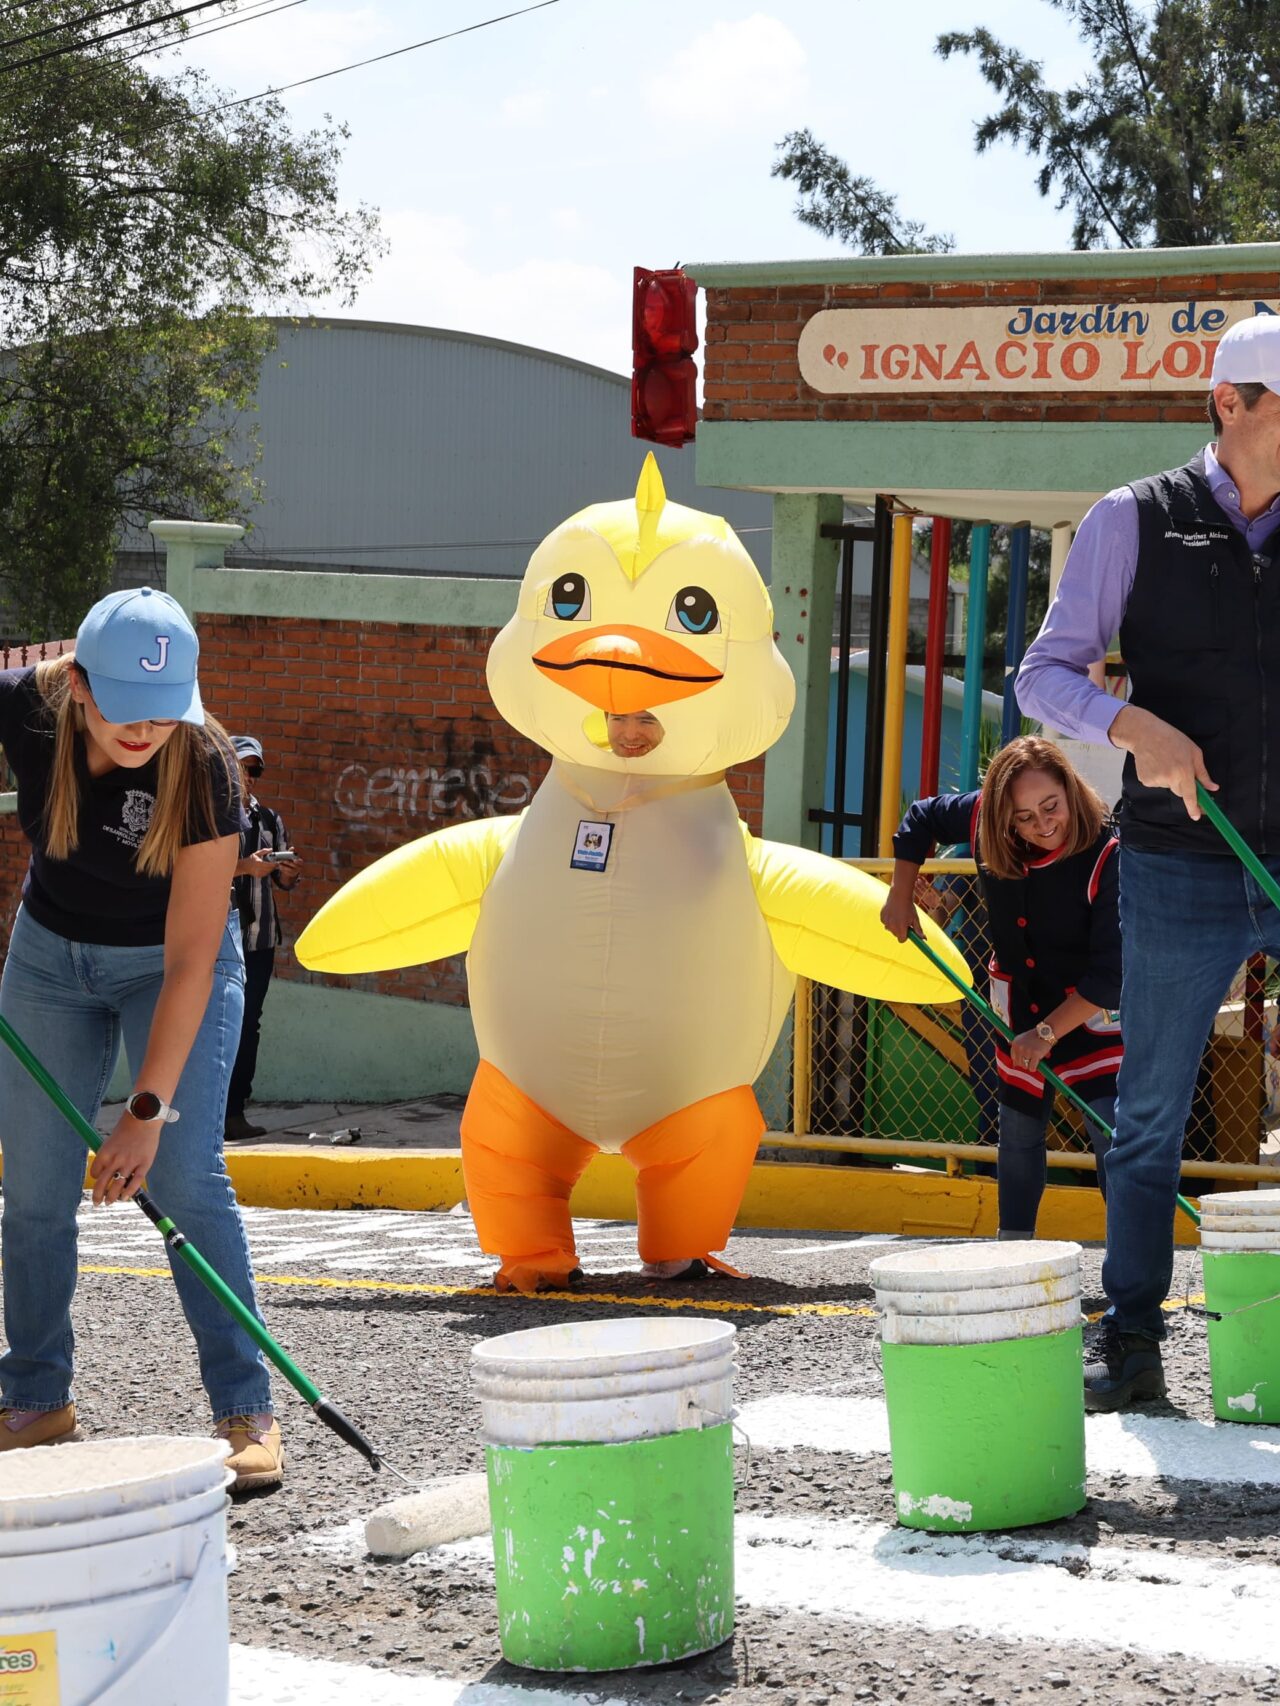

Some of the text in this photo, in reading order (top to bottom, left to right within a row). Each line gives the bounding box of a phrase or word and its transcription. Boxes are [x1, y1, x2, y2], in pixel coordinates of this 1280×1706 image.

[1007, 303, 1150, 336] Jardín
[1170, 302, 1229, 333] de
[139, 635, 170, 673] J
[0, 1653, 33, 1670] res
